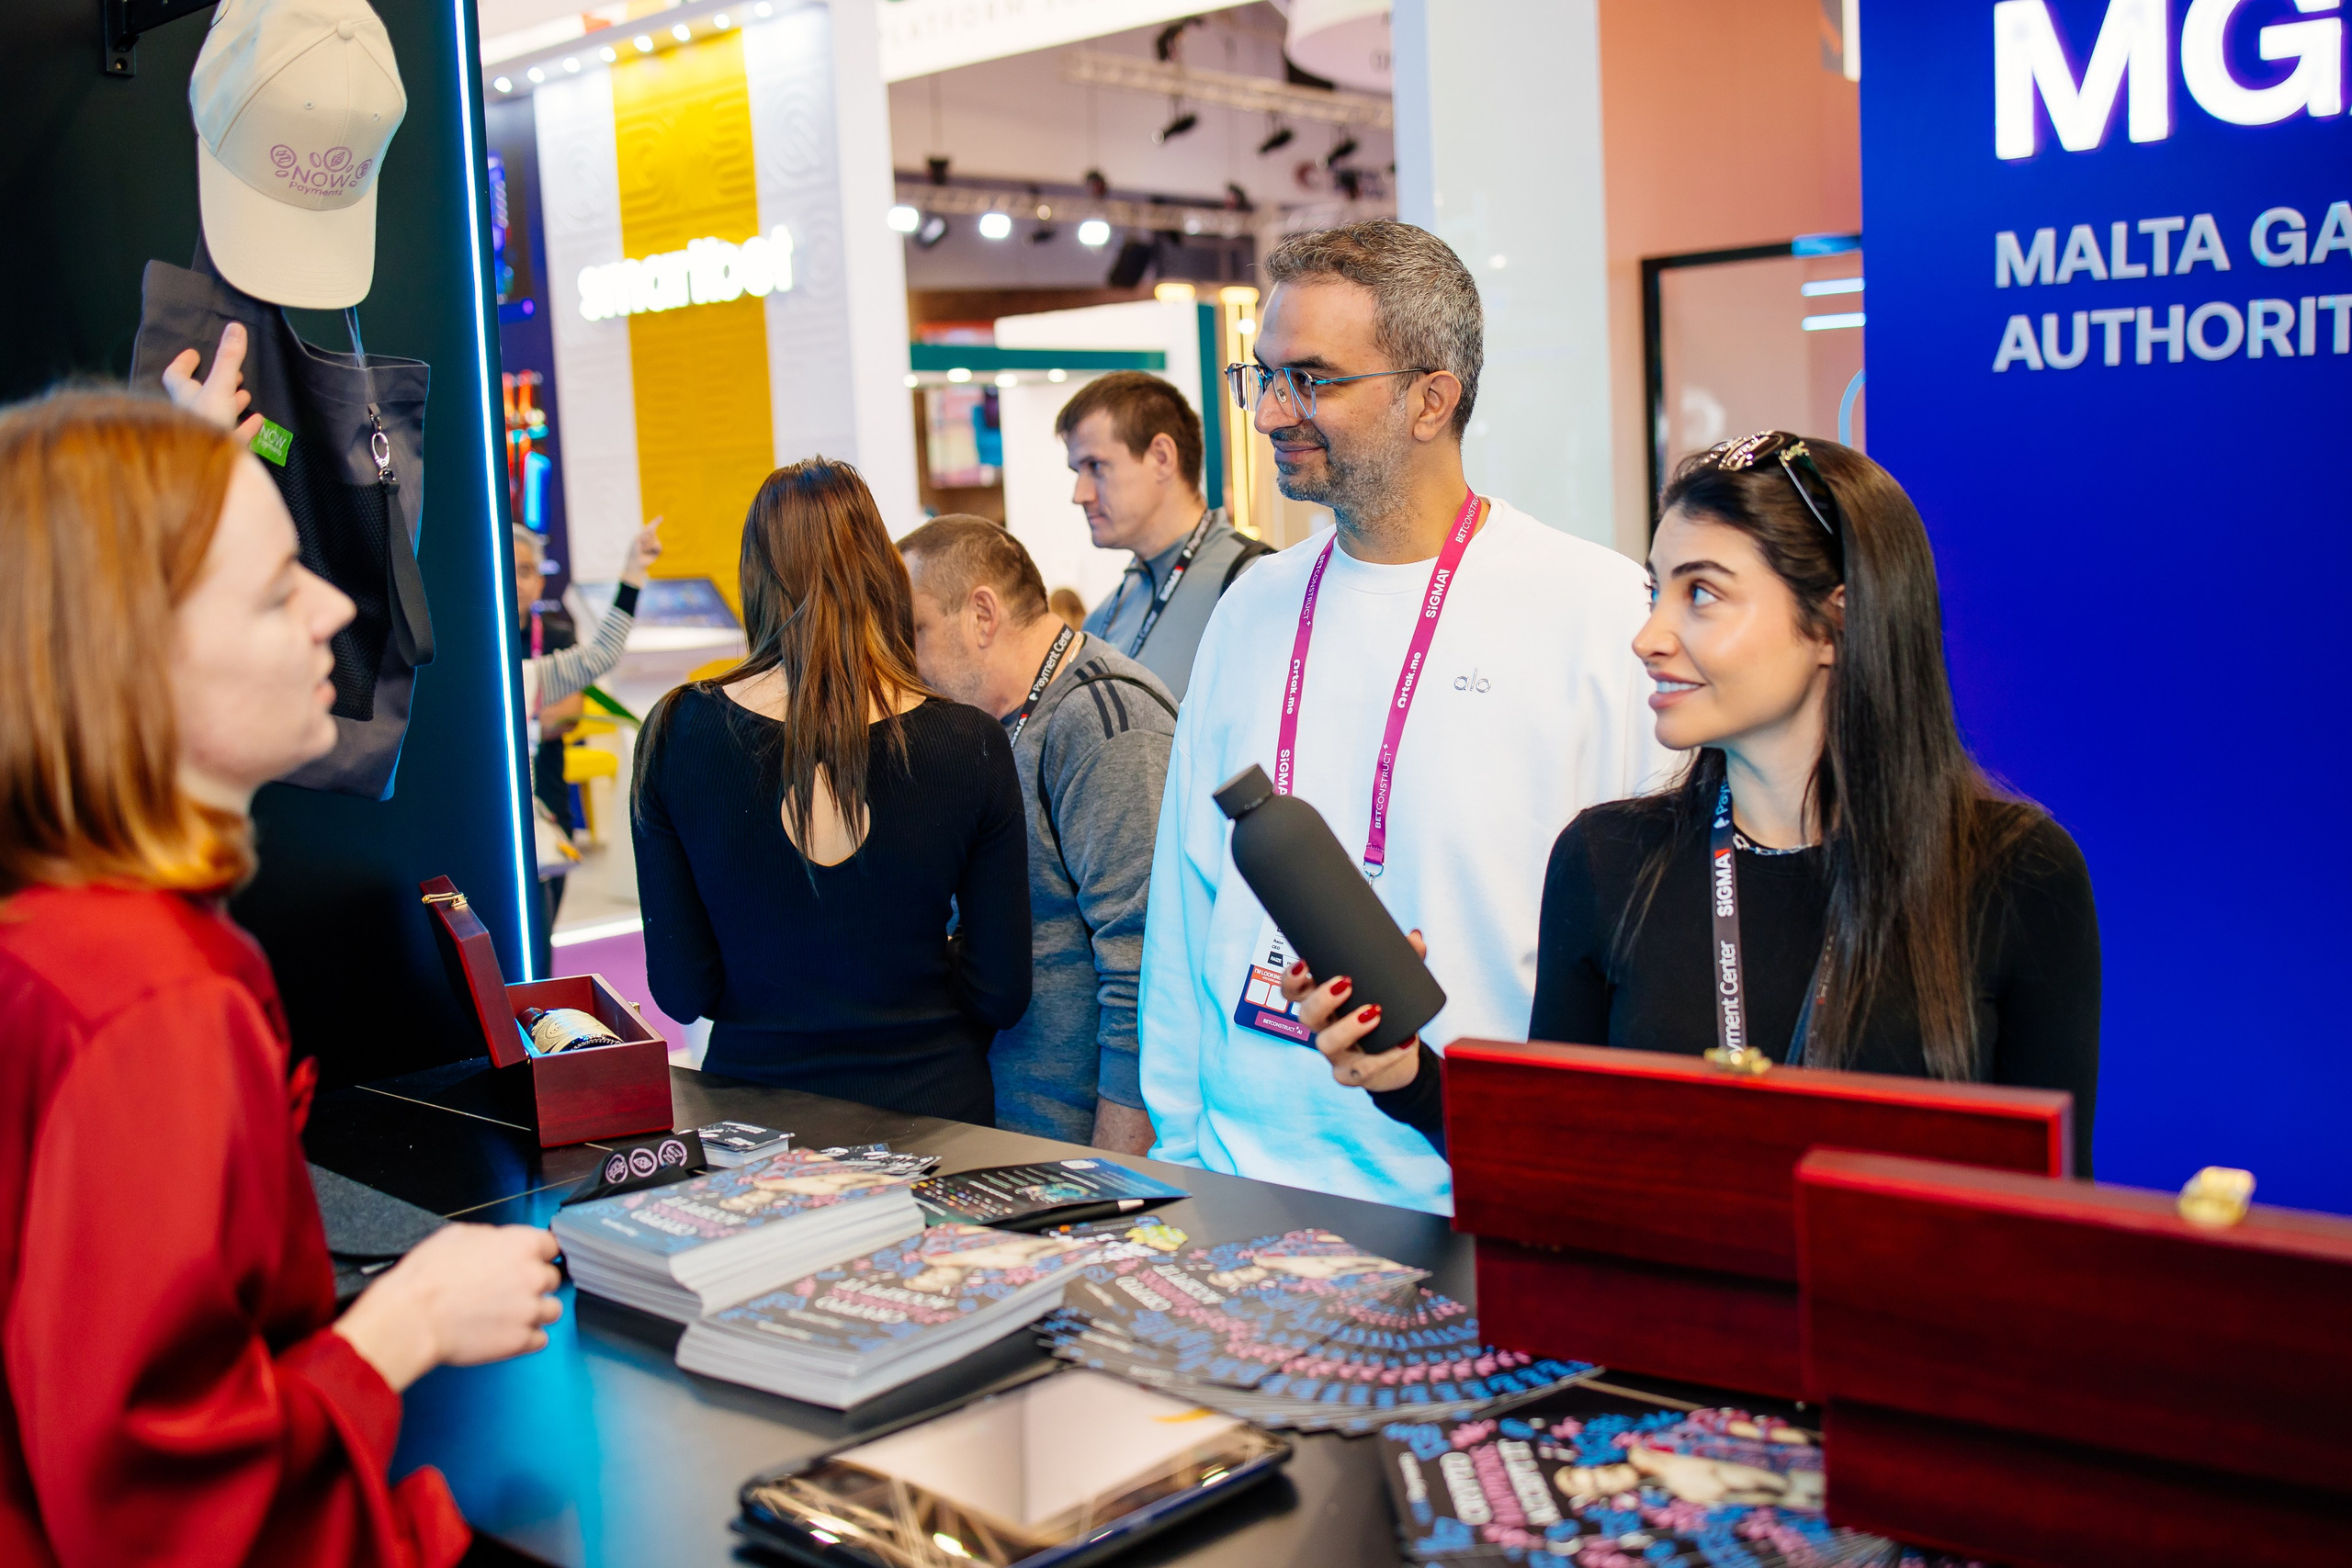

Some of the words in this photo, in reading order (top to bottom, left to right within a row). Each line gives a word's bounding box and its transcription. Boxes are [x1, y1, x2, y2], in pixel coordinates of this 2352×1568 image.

[292, 166, 352, 188] NOW
[1994, 214, 2232, 289] MALTA
[259, 425, 288, 448] NOW
[1303, 554, 1326, 620] BETCONSTRUCT
[1033, 650, 1061, 693] Payment
[1053, 627, 1073, 652] Center
[1453, 667, 1492, 694] alo
[1374, 750, 1393, 829] BETCONSTRUCT
[1719, 939, 1740, 996] Center
[1262, 1018, 1295, 1032] BETCONSTRUCT
